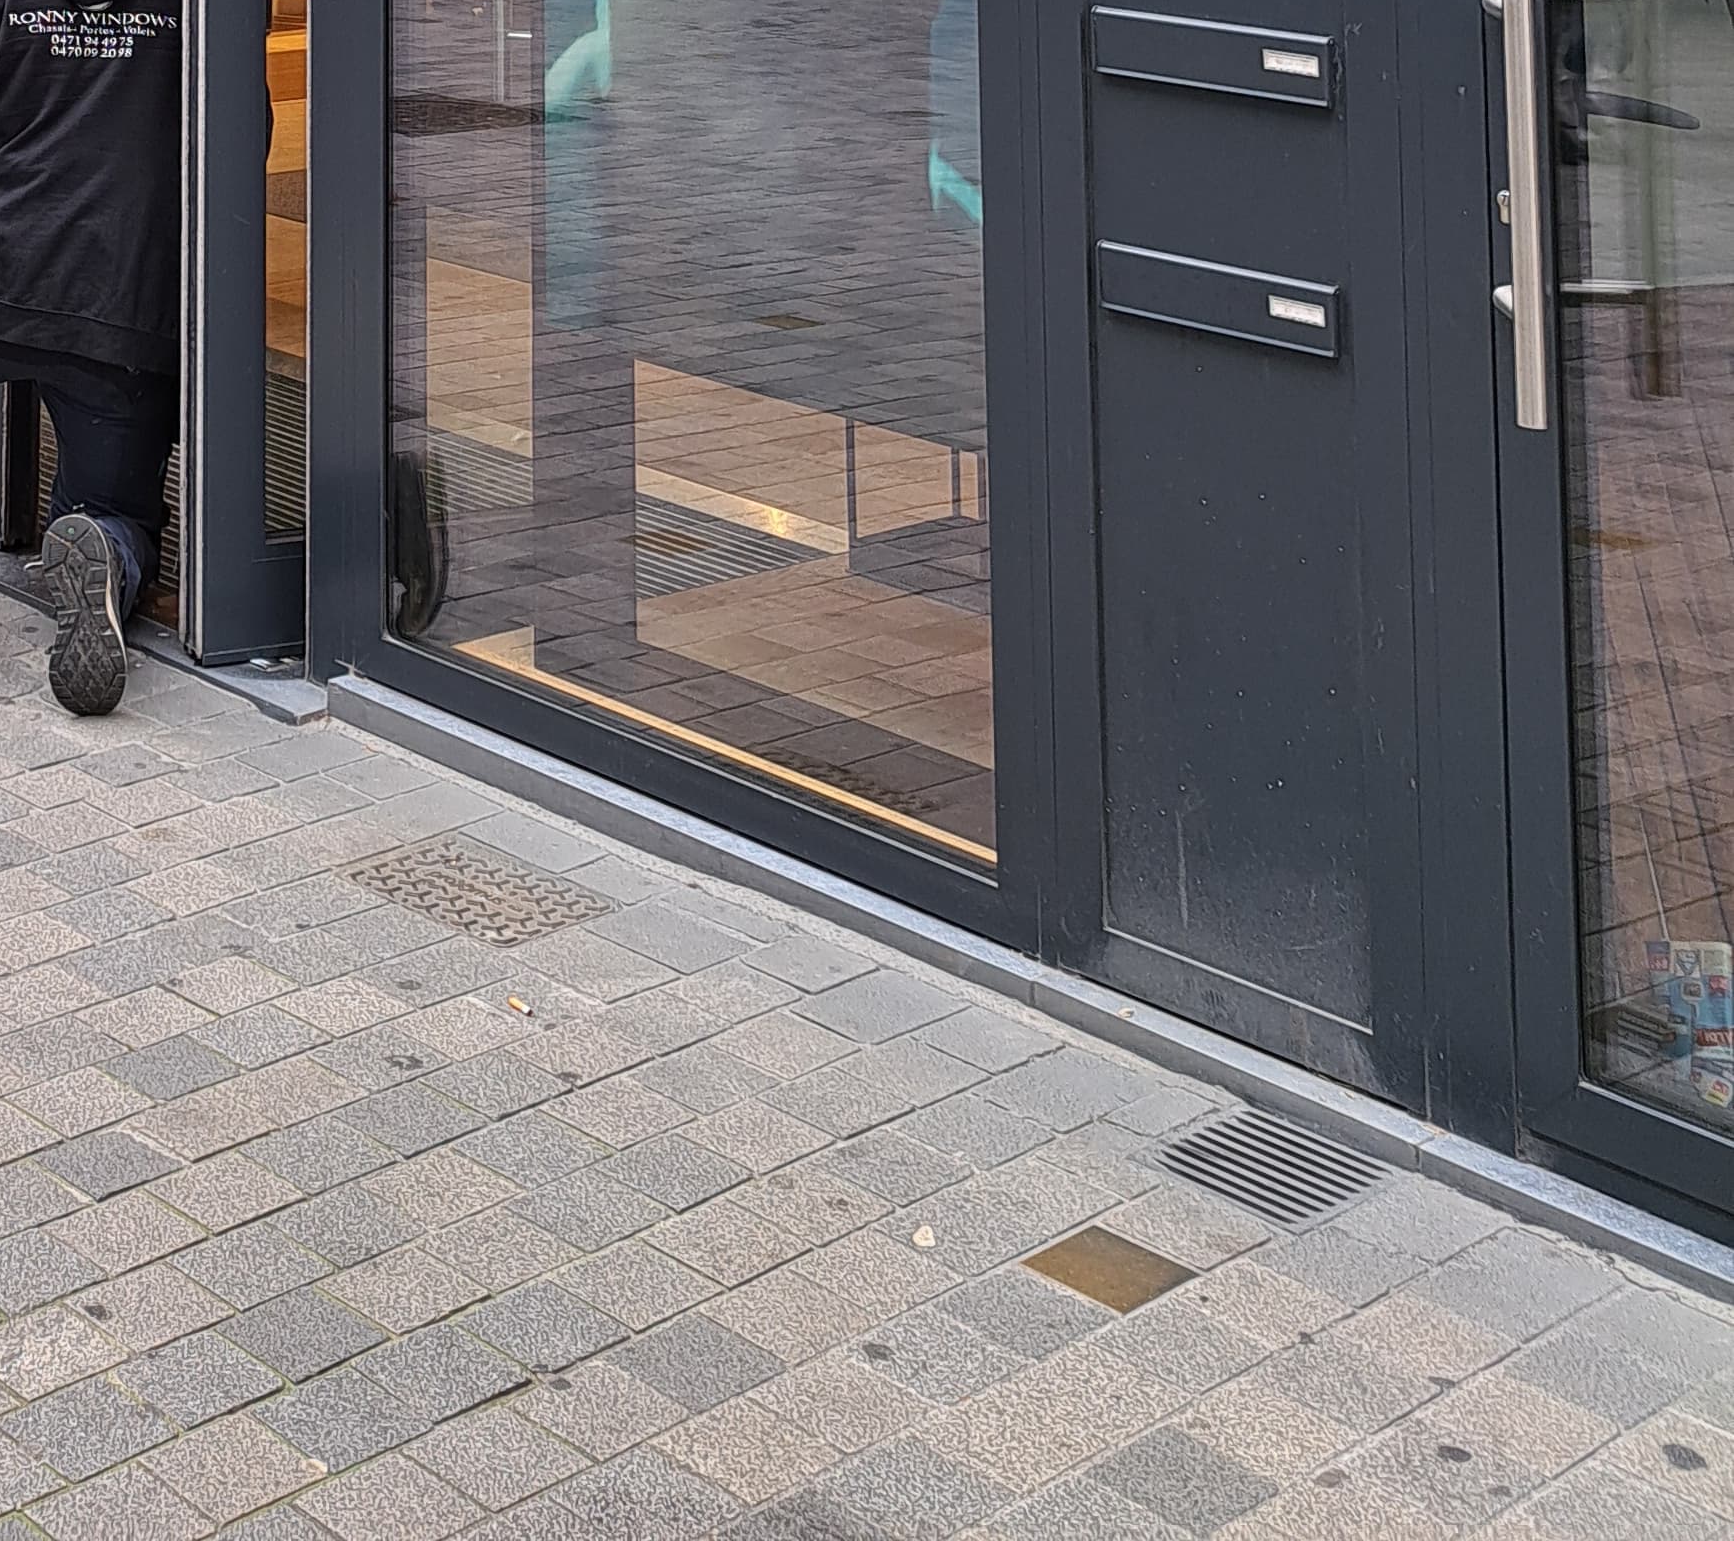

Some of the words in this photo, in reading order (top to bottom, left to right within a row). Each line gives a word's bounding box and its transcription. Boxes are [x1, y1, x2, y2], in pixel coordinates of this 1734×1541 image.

[8, 10, 79, 26] RONNY
[82, 11, 178, 30] WINDOWS
[51, 34, 81, 45] 0471
